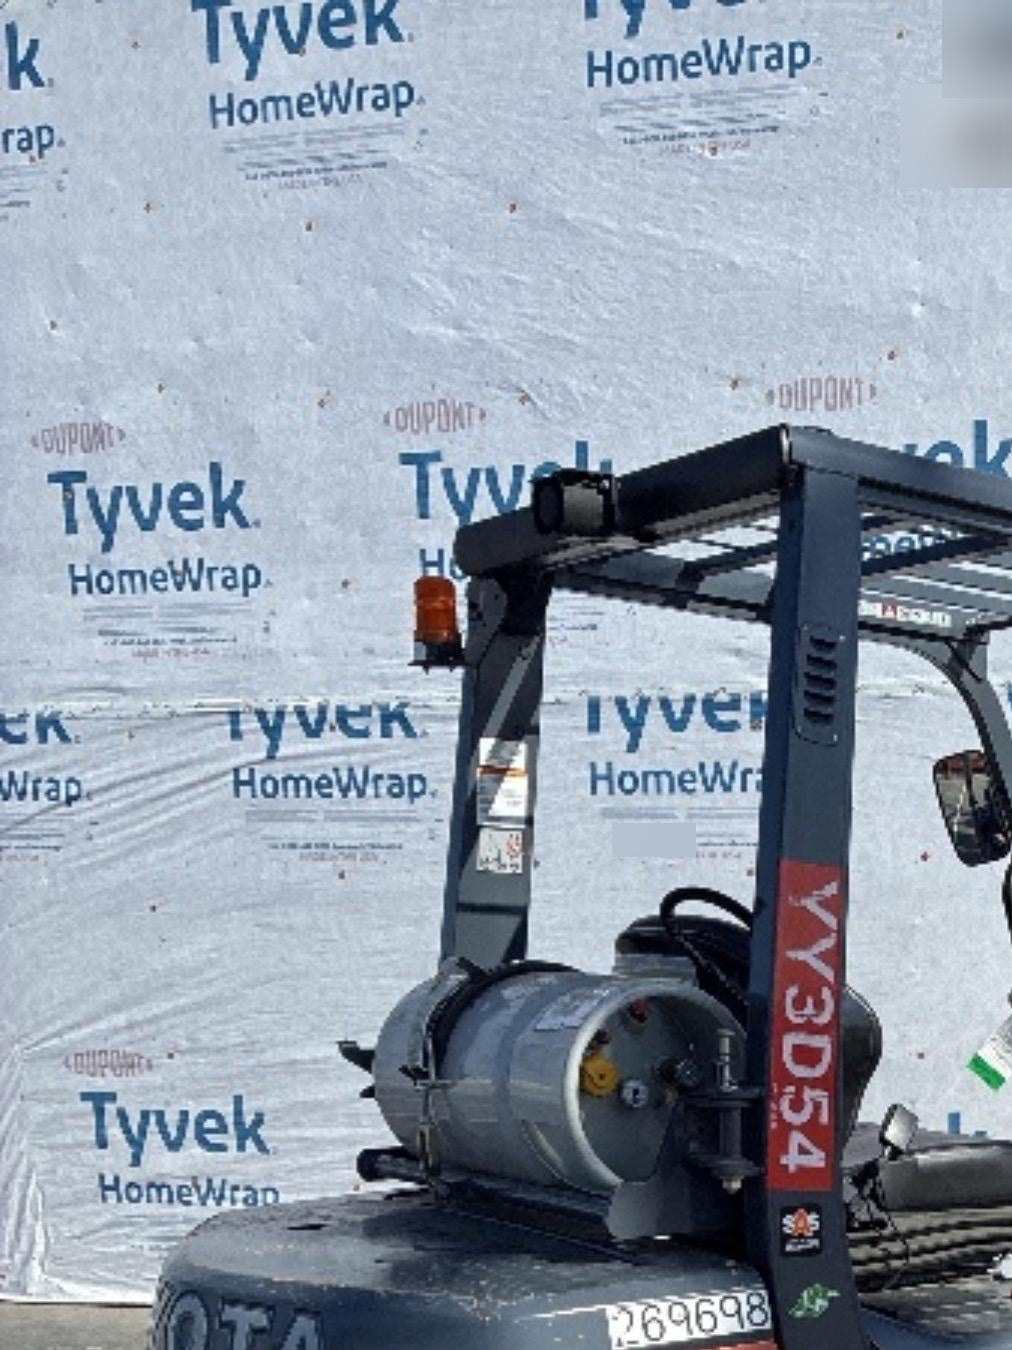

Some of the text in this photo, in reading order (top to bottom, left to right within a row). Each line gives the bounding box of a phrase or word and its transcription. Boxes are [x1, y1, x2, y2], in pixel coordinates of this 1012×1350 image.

[191, 0, 405, 81] Tyvek
[587, 35, 811, 88] HomeWrap
[209, 78, 415, 129] HomeWrap
[395, 399, 476, 434] DUPONT
[779, 376, 864, 411] DUPONT
[48, 461, 251, 553] Tyvek
[68, 557, 262, 598] HomeWrap
[232, 765, 427, 804] HomeWrap
[80, 1091, 270, 1167] Tyvek
[612, 1292, 769, 1348] 269698
